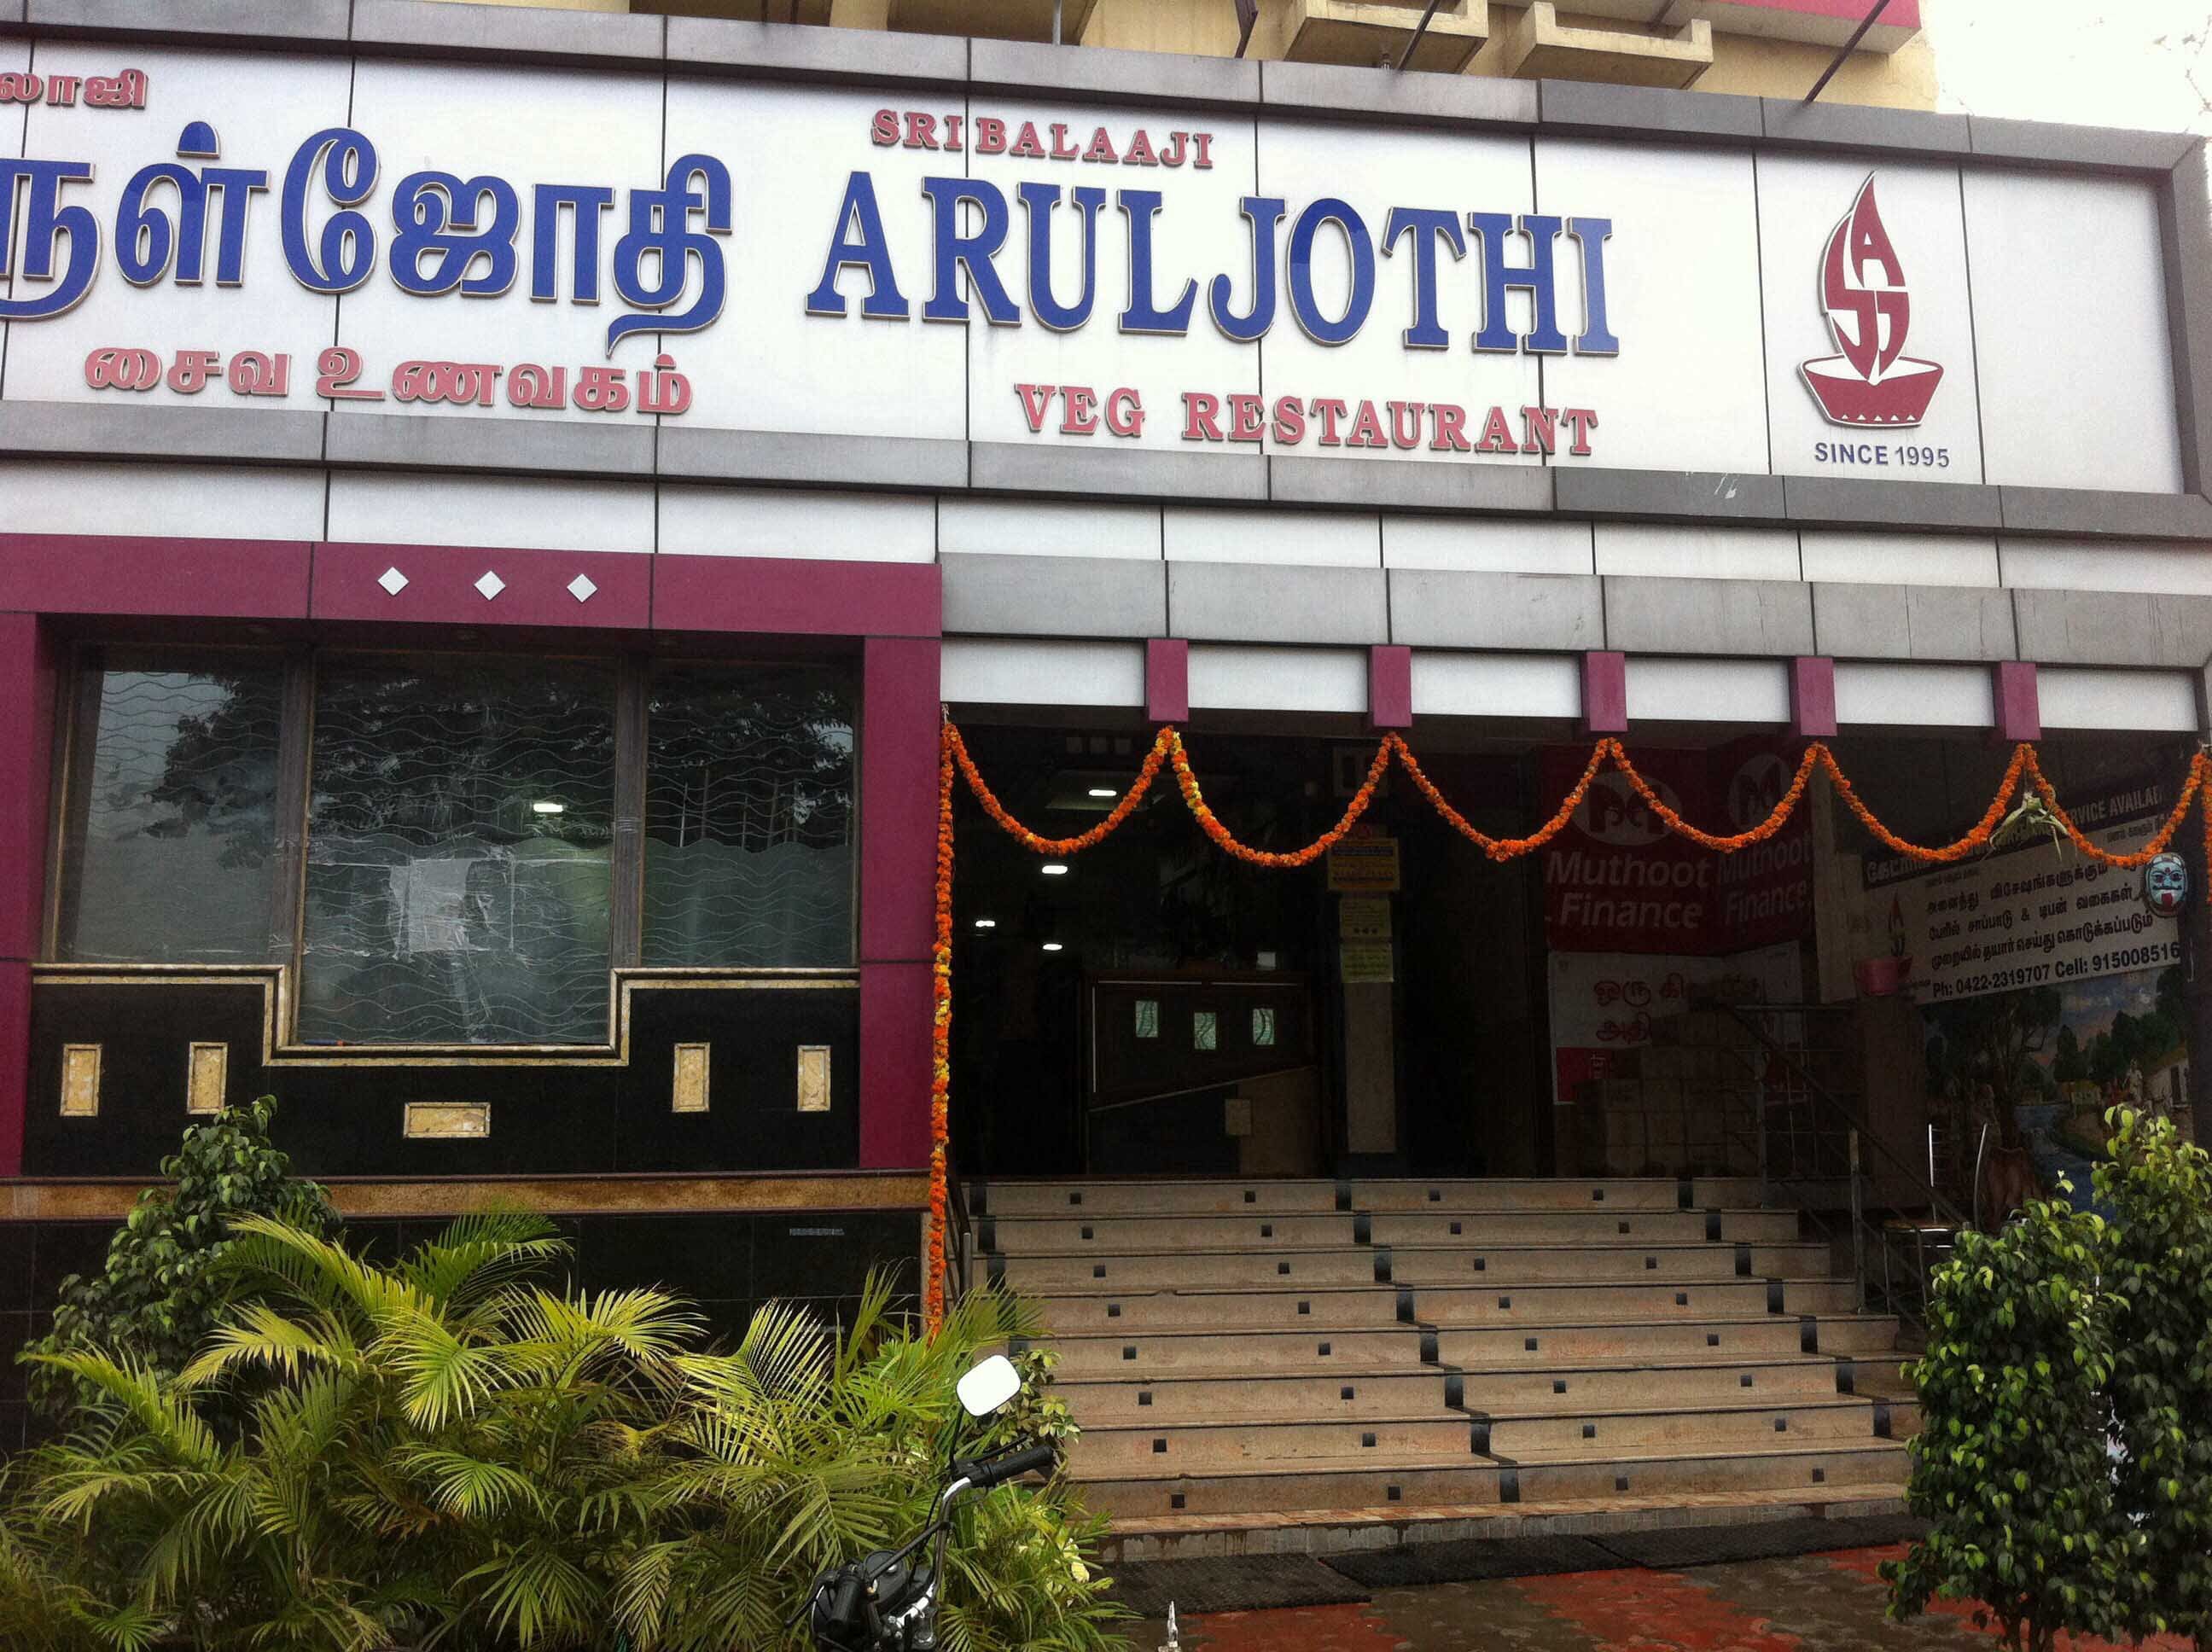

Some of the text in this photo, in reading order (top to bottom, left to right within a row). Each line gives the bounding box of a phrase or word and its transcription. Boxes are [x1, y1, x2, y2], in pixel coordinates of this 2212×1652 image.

[870, 108, 1214, 169] SRI BALAAJI
[84, 346, 693, 414] சைவ உணவகம்
[1014, 383, 1599, 457] VEG RESTAURANT
[1814, 442, 1949, 468] SINCE 1995
[2069, 800, 2106, 825] RVICE
[1545, 851, 1711, 888] Muthoot
[1718, 831, 1812, 884] Muthoot
[1561, 892, 1703, 929] Finance
[2076, 882, 2133, 910] வகைகள்
[2057, 910, 2154, 944] கொடுக்கப்படும்
[1933, 982, 1953, 998] Ph:
[1956, 964, 2050, 994] 0422-2319707
[2055, 958, 2087, 978] Cell:
